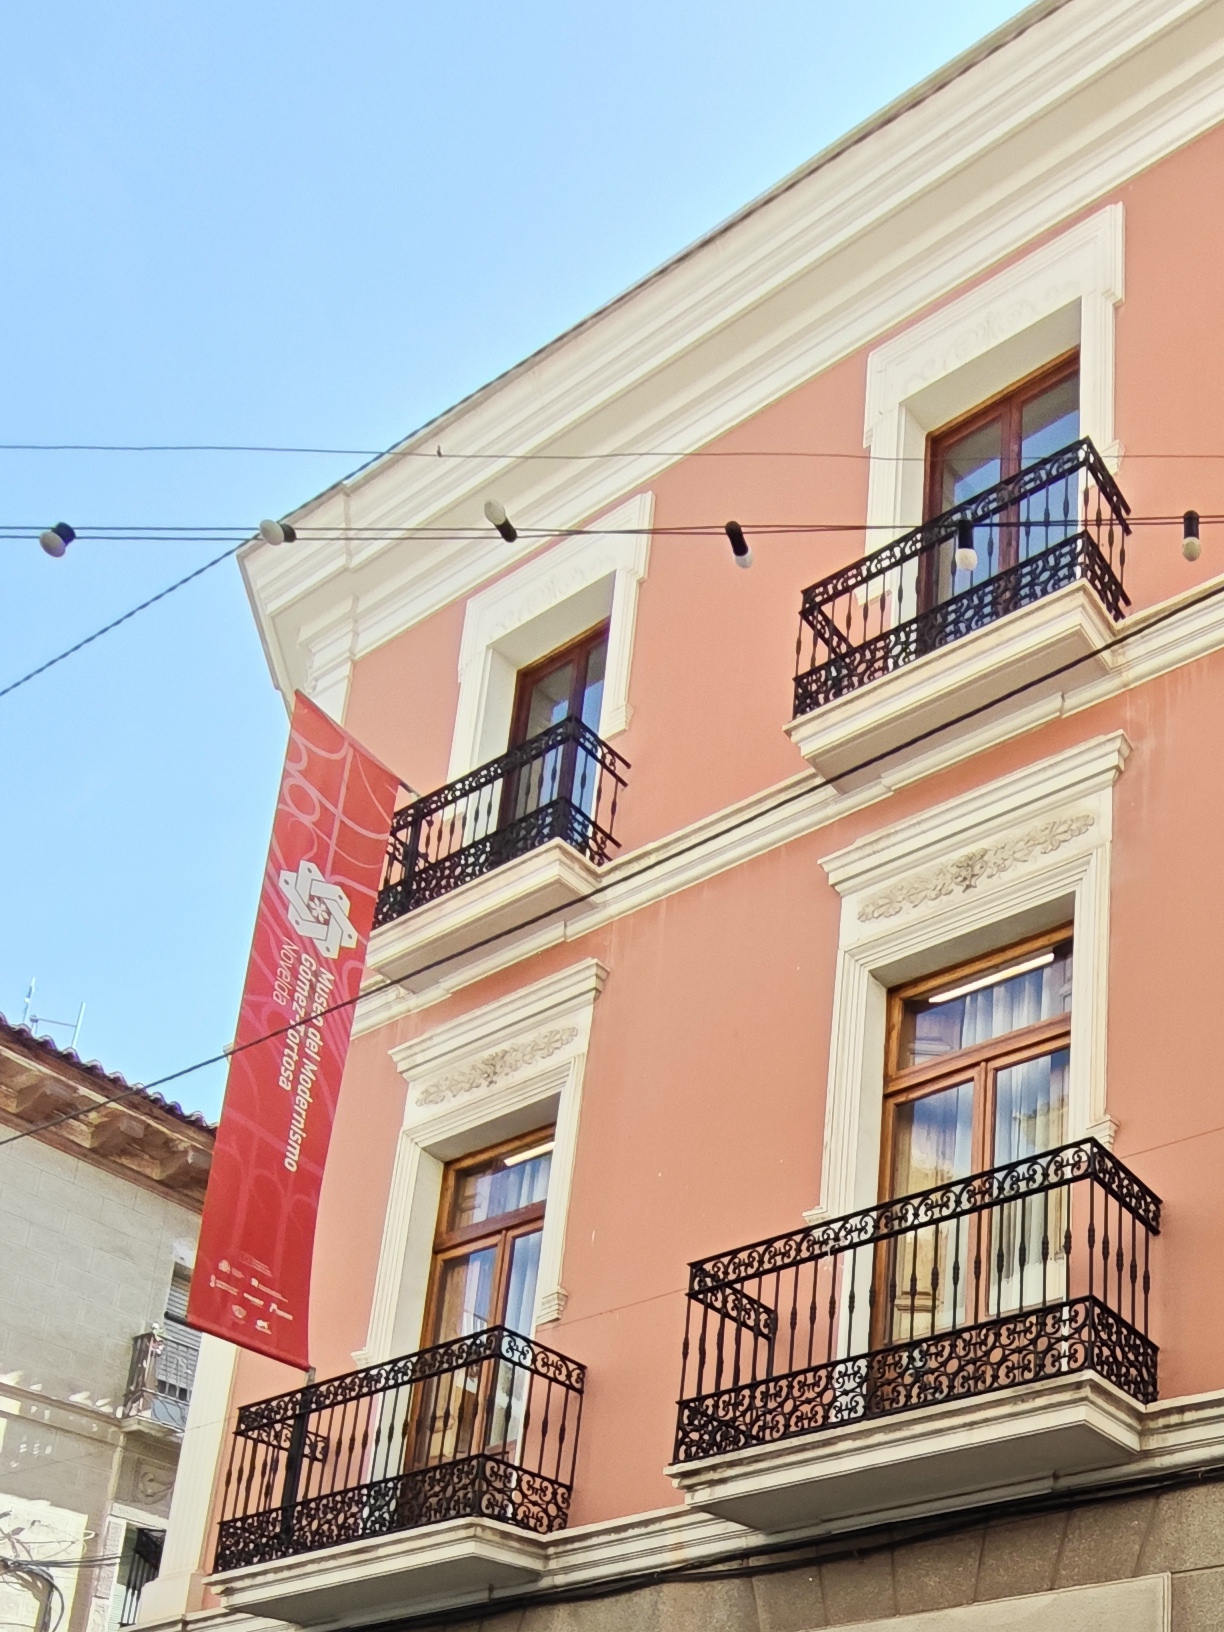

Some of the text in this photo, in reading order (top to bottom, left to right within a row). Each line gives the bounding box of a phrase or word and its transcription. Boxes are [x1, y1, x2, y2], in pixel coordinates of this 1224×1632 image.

[273, 936, 300, 1006] Novelda
[284, 967, 334, 1172] Museo del Modernismo
